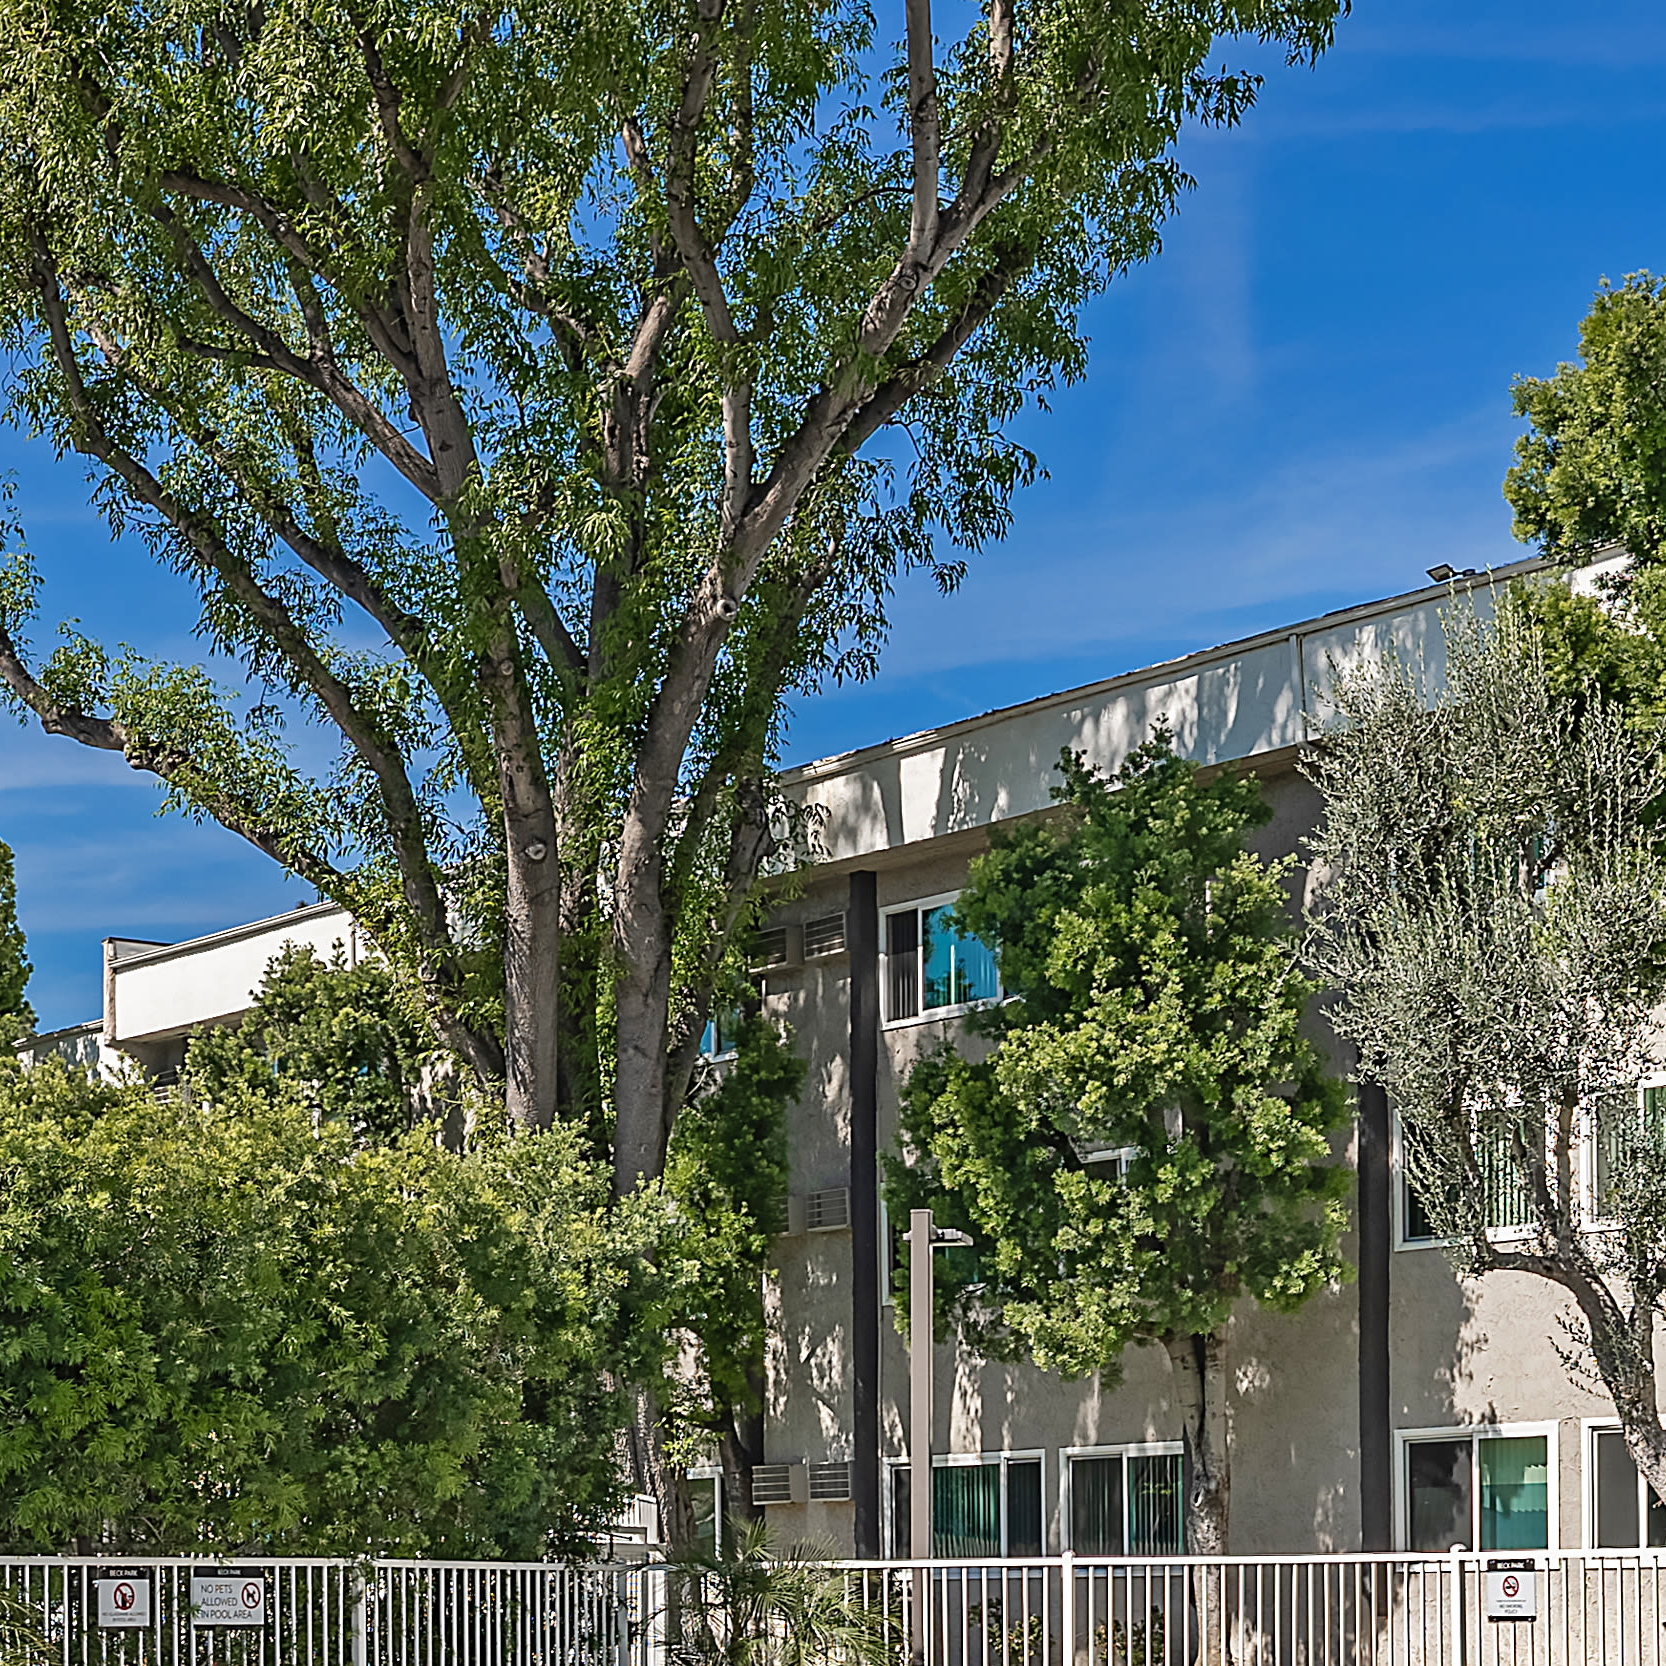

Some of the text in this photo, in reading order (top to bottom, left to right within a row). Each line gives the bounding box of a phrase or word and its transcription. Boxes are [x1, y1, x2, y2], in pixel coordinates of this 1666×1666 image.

[201, 1584, 233, 1593] NO PETS
[201, 1597, 238, 1607] ALLOWED
[201, 1610, 253, 1619] IN POOL AREA
